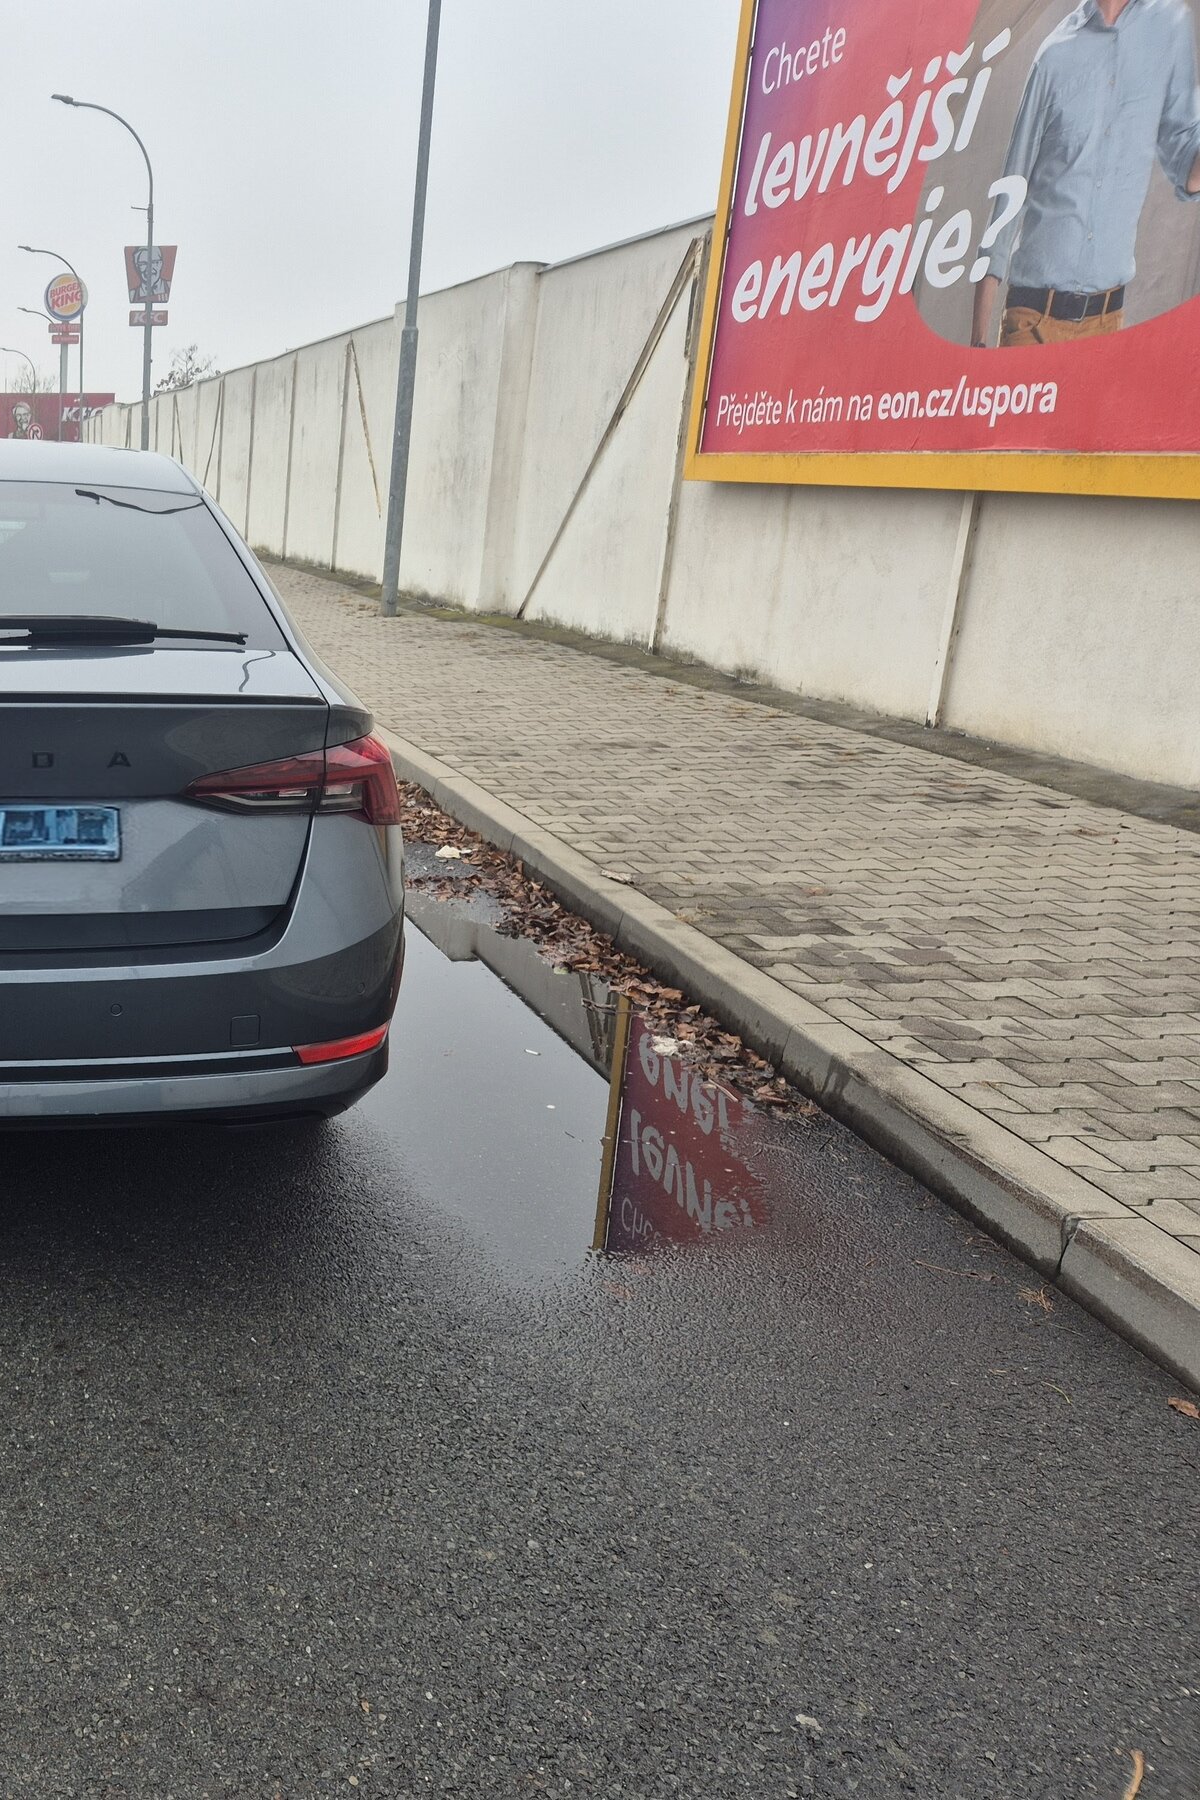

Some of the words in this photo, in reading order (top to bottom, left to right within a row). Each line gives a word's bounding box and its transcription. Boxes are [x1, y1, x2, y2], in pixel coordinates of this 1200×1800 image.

[761, 26, 847, 95] Chcete
[744, 27, 1012, 217] levnější
[731, 175, 1029, 323] energie?
[51, 290, 82, 309] KING
[716, 389, 782, 435] Přejděte
[785, 388, 798, 424] k
[800, 385, 843, 423] nám
[847, 393, 873, 421] na
[877, 375, 1059, 427] eon.cz/uspora
